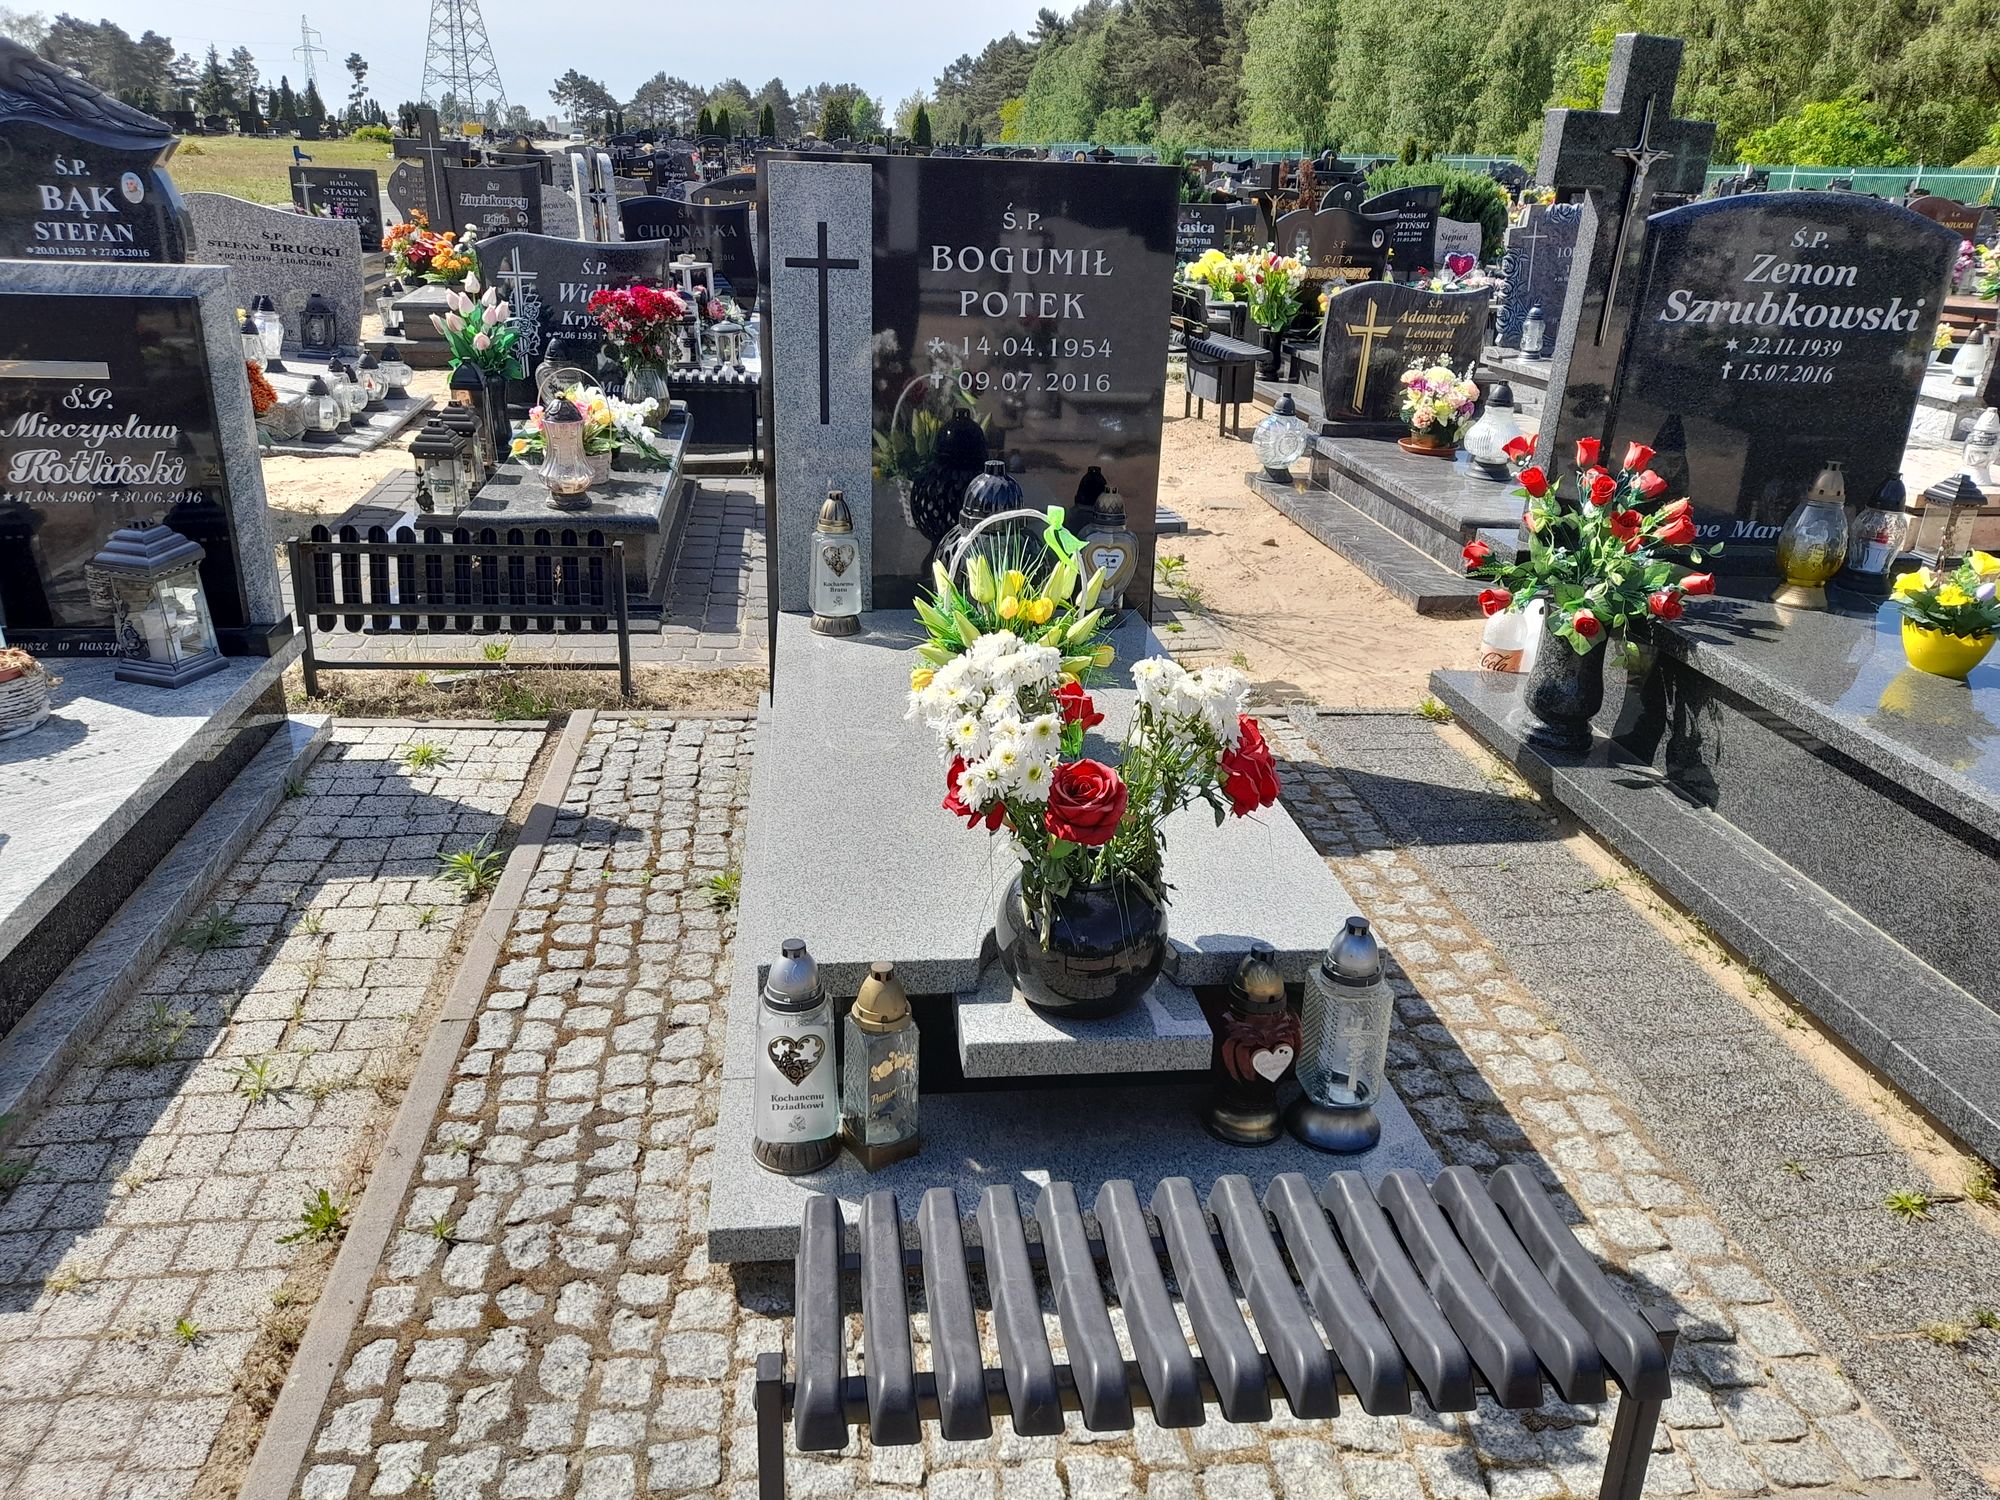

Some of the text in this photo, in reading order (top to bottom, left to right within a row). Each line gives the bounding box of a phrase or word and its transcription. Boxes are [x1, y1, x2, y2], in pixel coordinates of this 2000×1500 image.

[54, 154, 91, 176] Ś.P.
[38, 184, 120, 219] BĄK
[322, 188, 368, 197] STASIAK
[1003, 202, 1044, 231] Ś.P.
[33, 221, 135, 243] STEFAN
[1790, 227, 1830, 249] Ś.P.
[100, 248, 150, 257] 27.05.2016
[207, 240, 342, 257] STEFAN BRUCKI
[1321, 254, 1353, 264] RITA
[580, 258, 608, 275] Ś.P.
[931, 245, 1114, 277] BOGUMIŁ
[1744, 254, 1858, 287] Zenon
[959, 291, 1086, 319] POTEK
[1659, 290, 1926, 332] Szrubkowski
[1397, 310, 1468, 325] Adamczak
[1405, 327, 1455, 340] Leonard
[963, 336, 1113, 358] 14.04.1954
[1746, 337, 1843, 358] 22.11.1939
[958, 372, 1111, 392] 09.07.2016
[1738, 363, 1836, 384] 15.07.2016
[1, 411, 180, 448] Mieczysław
[8, 449, 188, 485] Kotliński
[121, 491, 203, 504] 30.06.2016
[1481, 652, 1513, 672] Cola
[771, 1093, 824, 1102] Kochanemu
[771, 1102, 824, 1111] Dziadkowi
